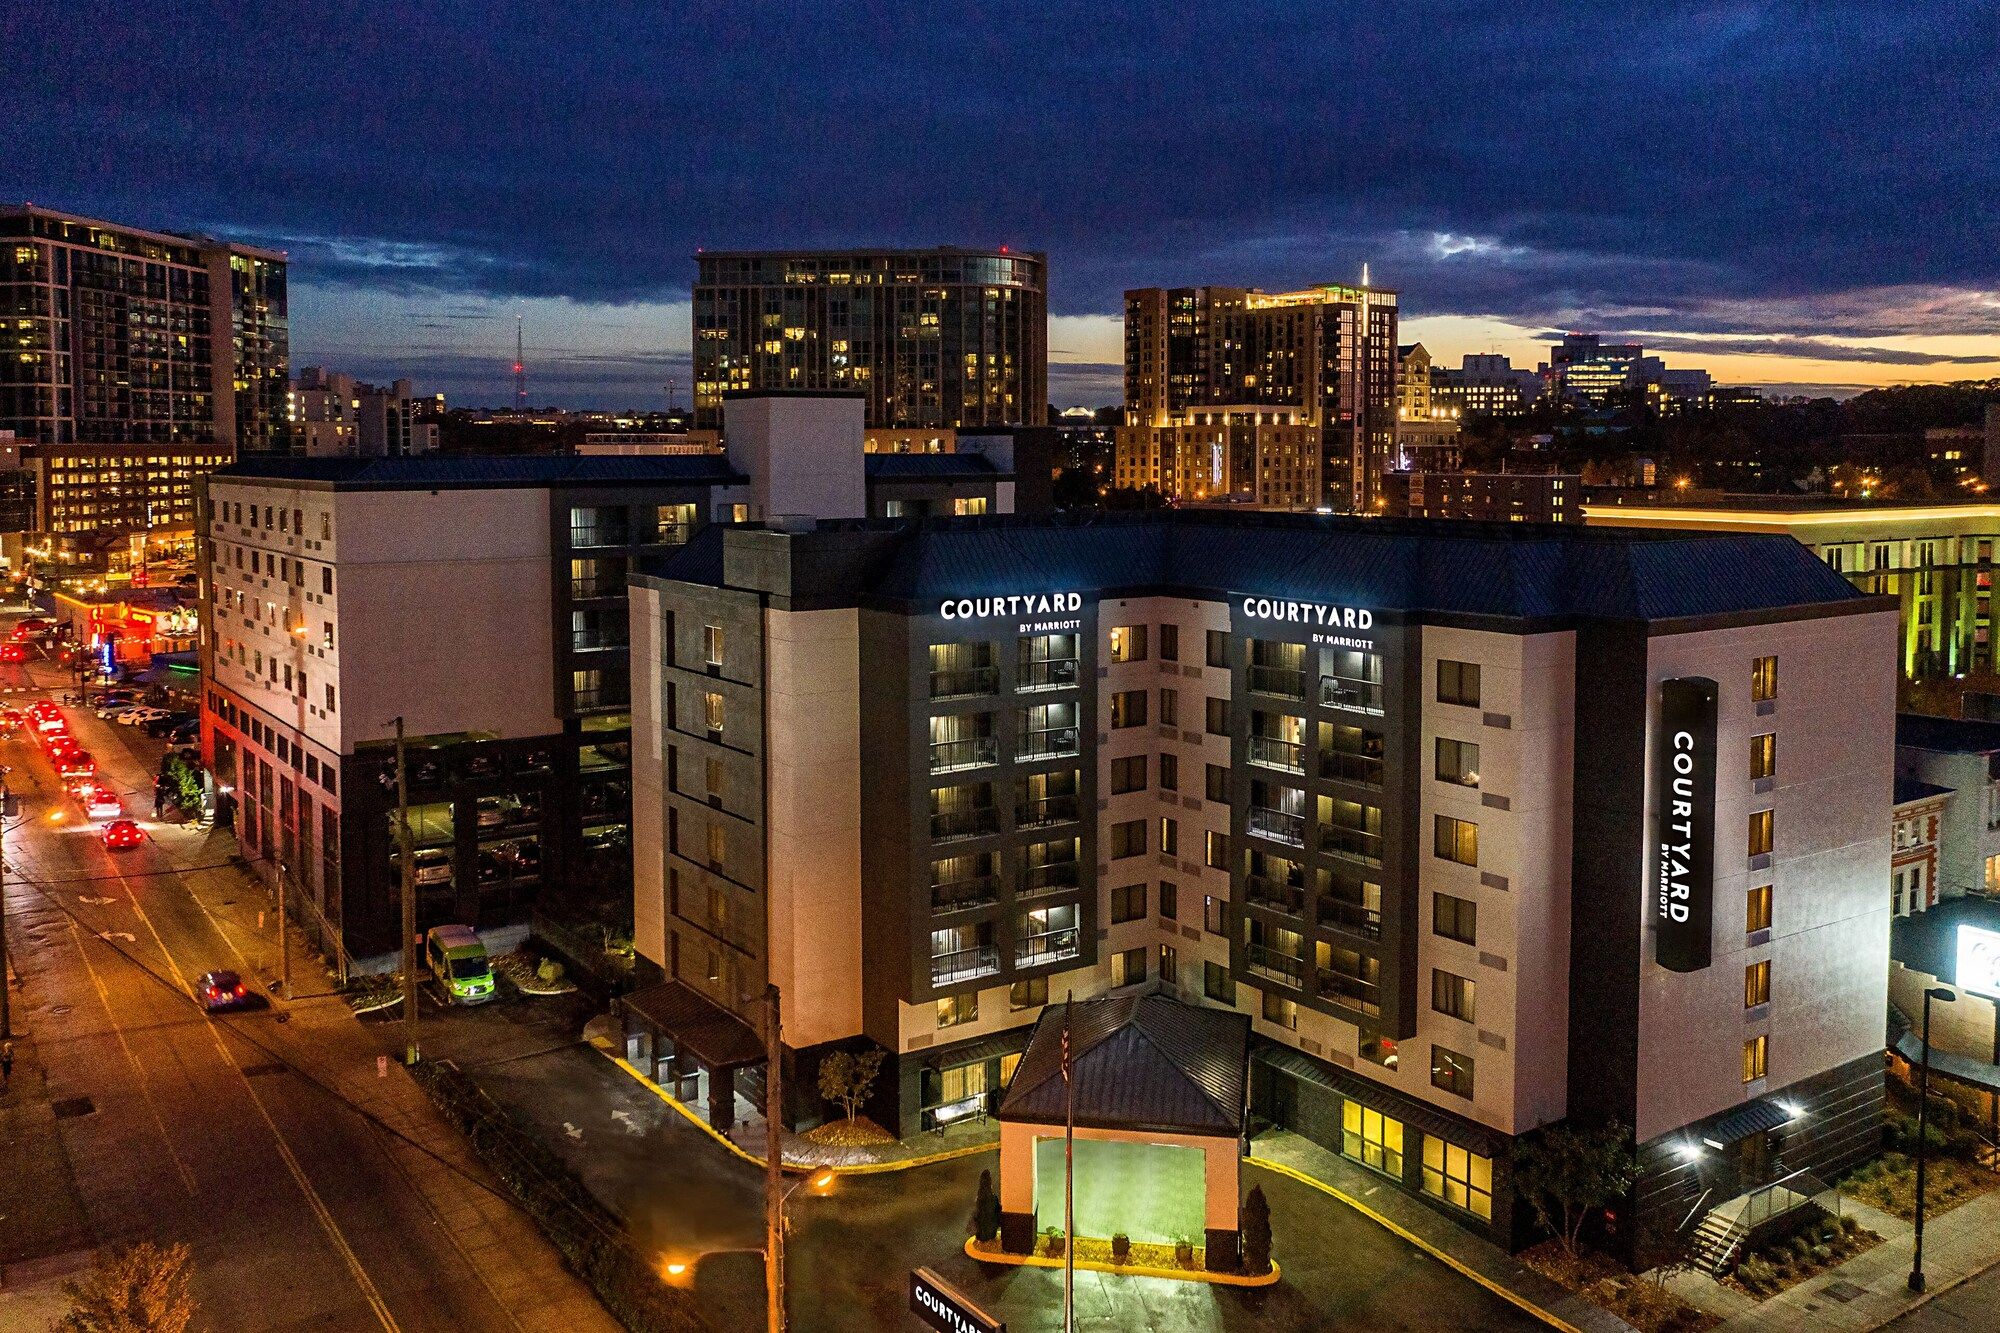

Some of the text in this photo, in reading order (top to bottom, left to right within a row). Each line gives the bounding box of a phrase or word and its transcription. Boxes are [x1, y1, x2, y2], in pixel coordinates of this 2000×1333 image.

[940, 592, 1082, 620] COURTYARD
[1243, 597, 1373, 630] COURTYARD
[1019, 619, 1081, 633] BY MARRIOTT
[1312, 633, 1374, 650] BY MARRIOTT
[1670, 731, 1694, 923] COURTYARD
[1659, 843, 1669, 919] BY MARRIOTT
[915, 1285, 982, 1333] COURTYAR
